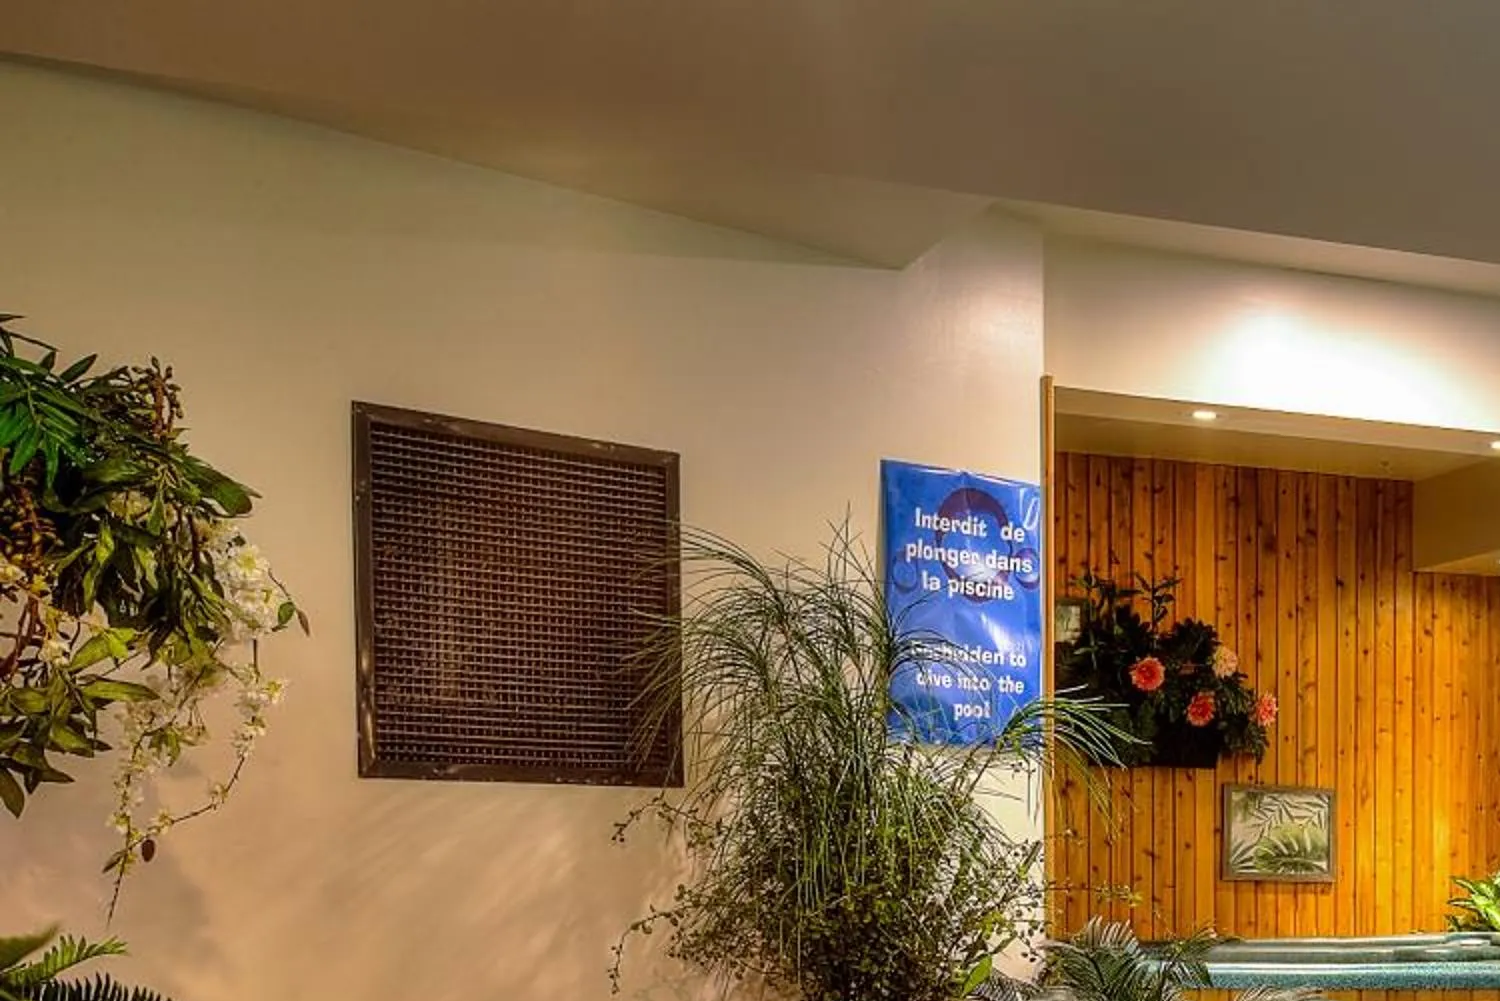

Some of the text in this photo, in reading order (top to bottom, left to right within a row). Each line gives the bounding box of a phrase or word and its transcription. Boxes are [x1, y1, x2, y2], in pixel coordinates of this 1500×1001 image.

[915, 506, 1026, 543] Interdit de
[906, 537, 1033, 573] plonger dans
[921, 570, 1015, 601] la piscine
[910, 638, 1027, 668] bidden to
[957, 671, 991, 692] into
[998, 674, 1025, 694] the
[953, 700, 991, 722] pool
